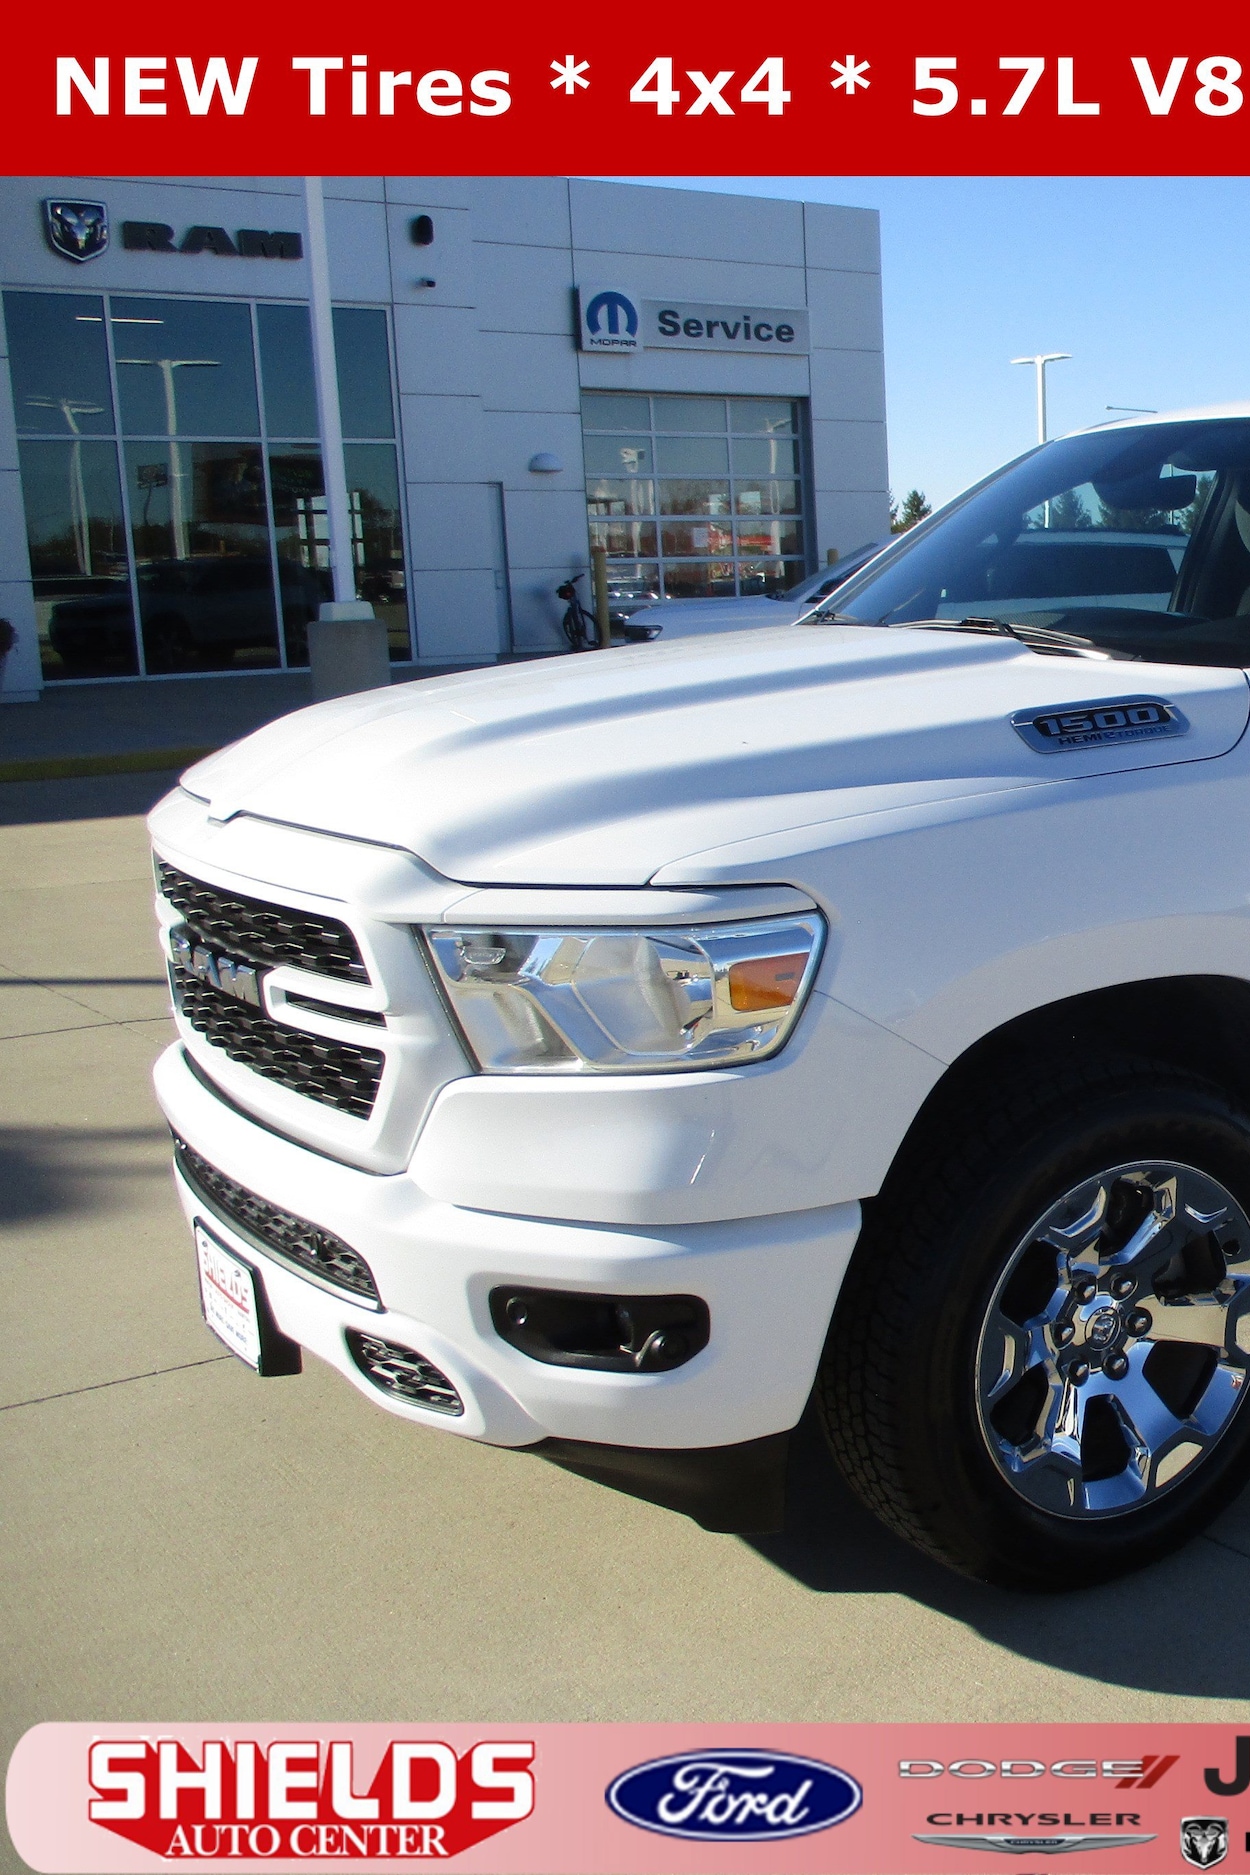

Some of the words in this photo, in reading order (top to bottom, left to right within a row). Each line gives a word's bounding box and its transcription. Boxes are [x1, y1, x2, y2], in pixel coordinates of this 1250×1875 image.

[122, 220, 303, 259] RAM
[657, 309, 795, 343] Service
[590, 338, 637, 347] MOPAR
[1040, 706, 1160, 735] 1500
[1058, 733, 1103, 746] HEMI
